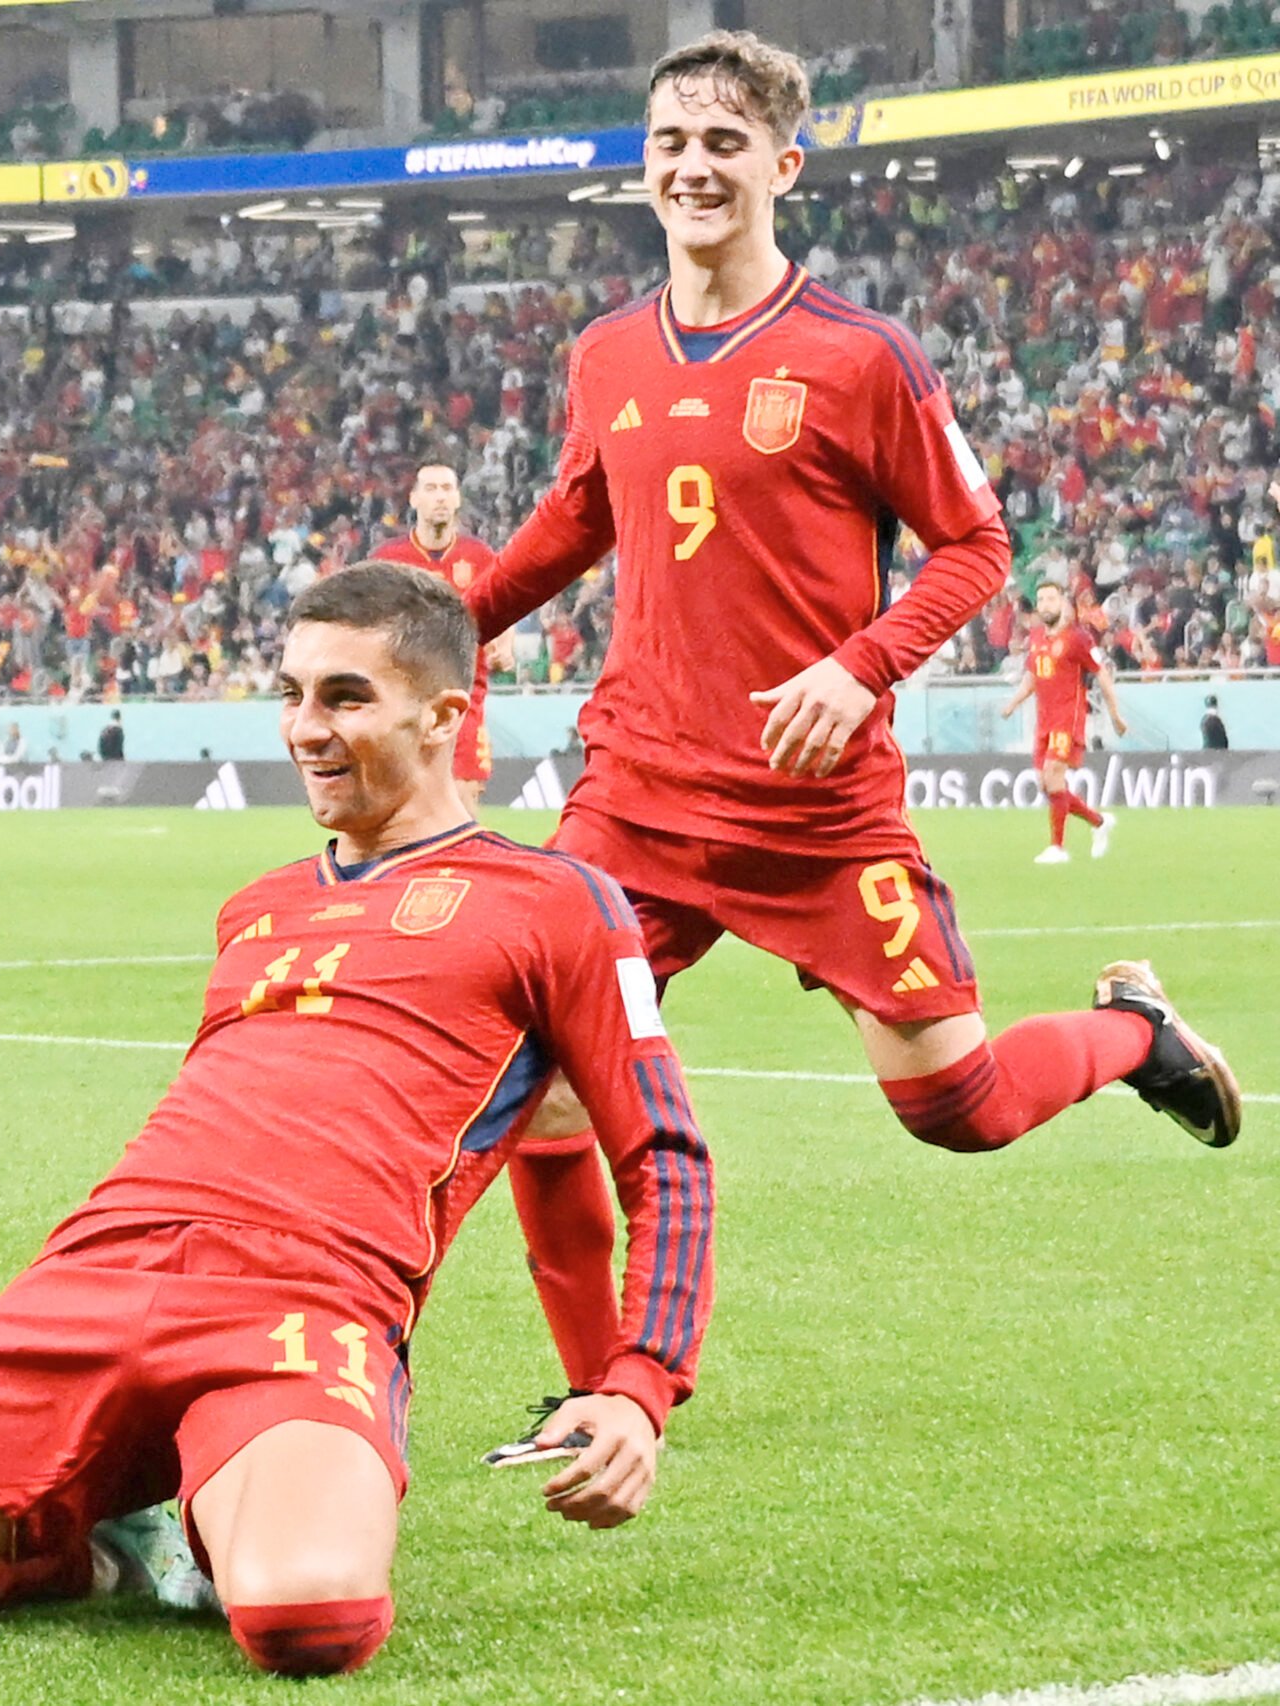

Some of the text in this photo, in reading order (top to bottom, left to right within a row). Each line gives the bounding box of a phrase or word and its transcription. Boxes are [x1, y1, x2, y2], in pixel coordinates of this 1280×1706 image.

[1069, 88, 1109, 110] FIFA
[1112, 79, 1183, 106] WORLD
[1187, 74, 1225, 98] CUP
[404, 137, 596, 174] #FIFAWorldCup
[666, 464, 717, 561] 9
[857, 860, 921, 958] 9
[241, 942, 352, 1017] 11
[267, 1311, 377, 1397] 11
